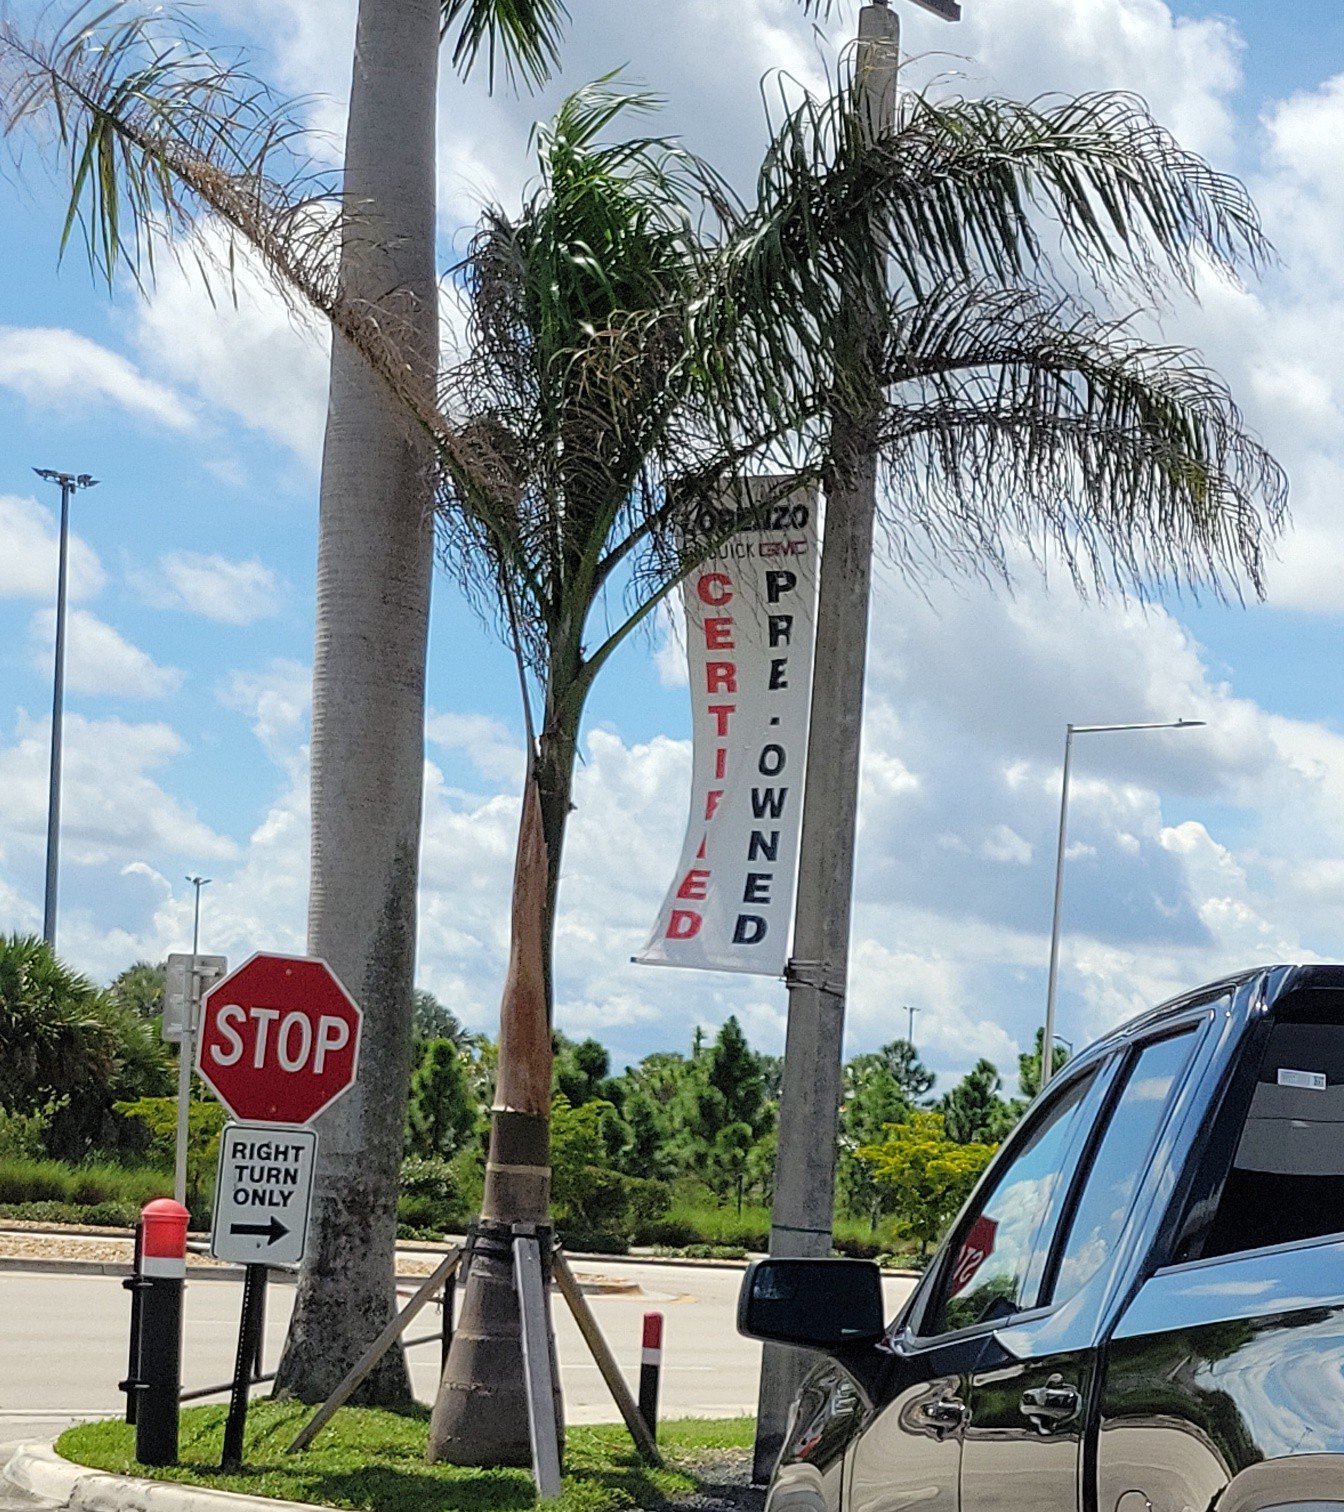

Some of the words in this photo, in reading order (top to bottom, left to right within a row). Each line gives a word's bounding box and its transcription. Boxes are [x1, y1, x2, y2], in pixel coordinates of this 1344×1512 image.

[210, 1004, 350, 1074] STOP
[231, 1141, 306, 1163] RIGHT
[234, 1165, 298, 1185] TURN
[233, 1187, 295, 1208] ONLY
